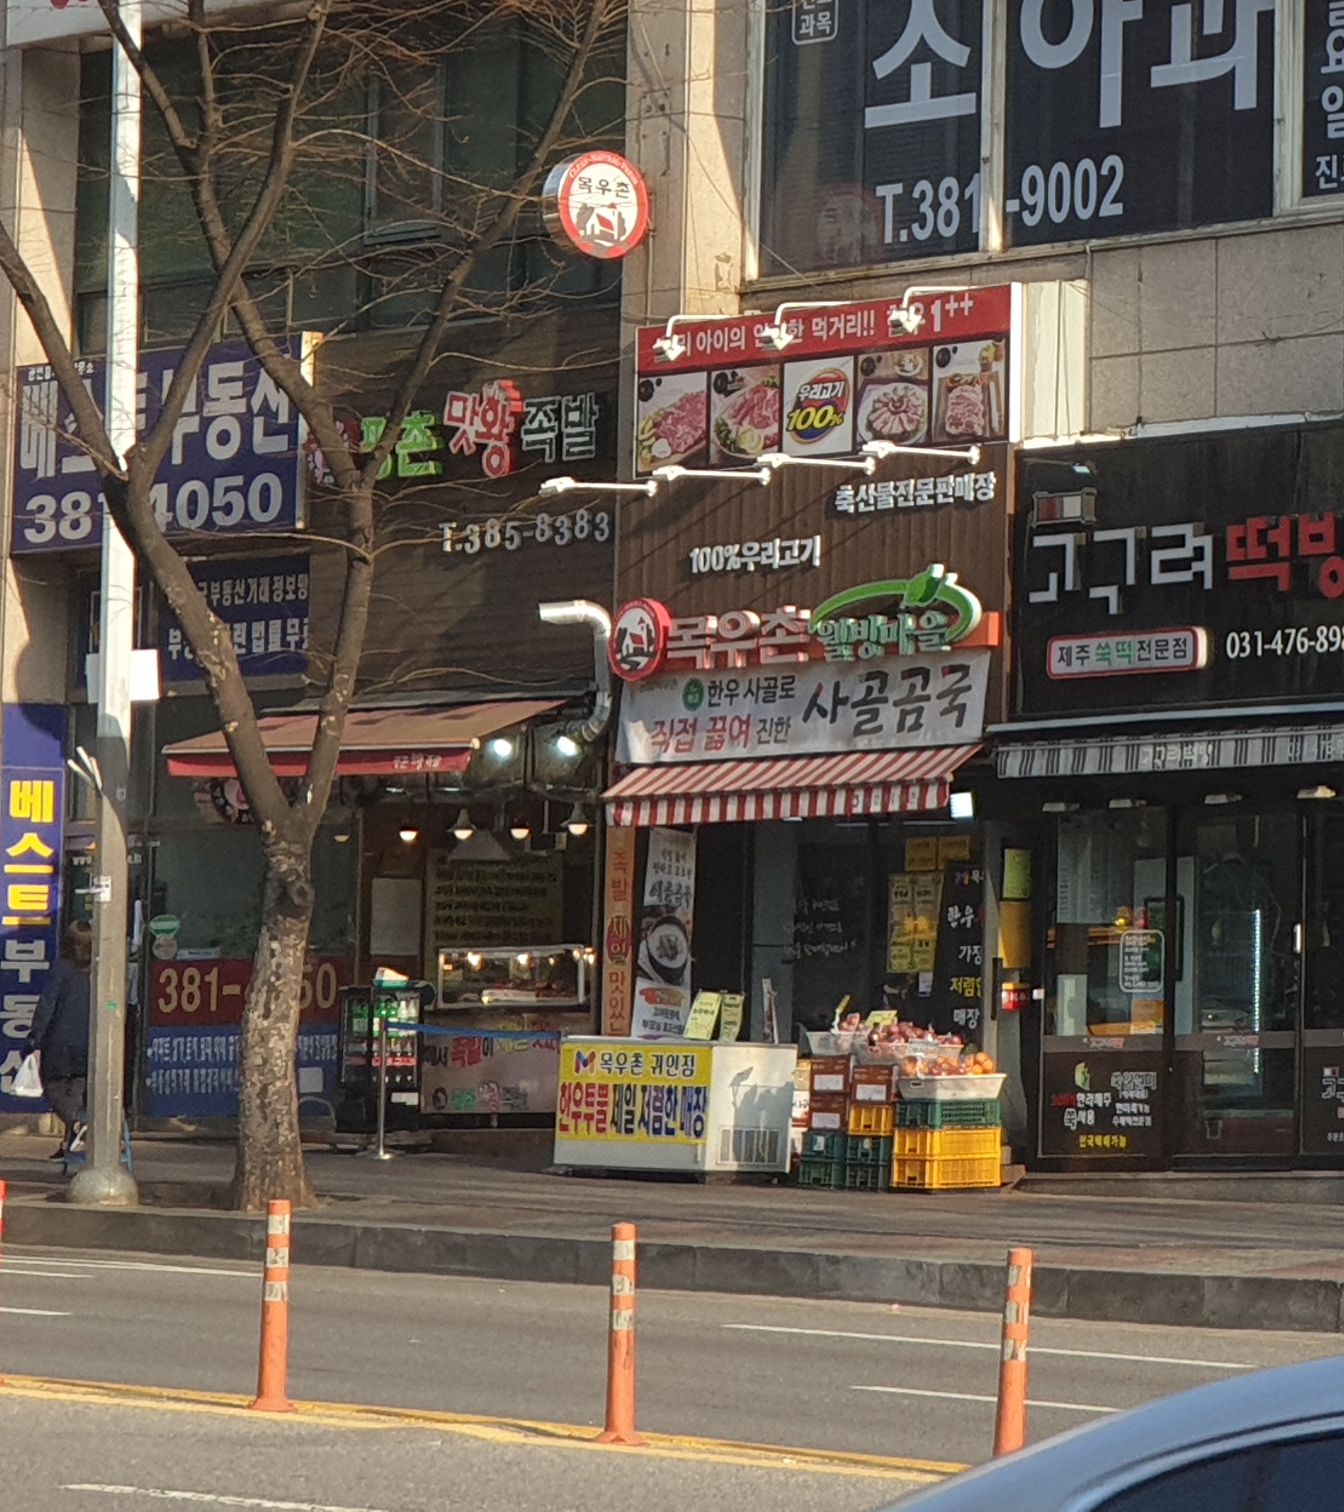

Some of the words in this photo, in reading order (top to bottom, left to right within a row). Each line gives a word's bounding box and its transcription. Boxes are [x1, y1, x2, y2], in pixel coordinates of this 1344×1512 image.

[799, 11, 834, 38] 과목
[696, 326, 746, 352] 아이의
[811, 310, 876, 339] 먹거리!!
[798, 381, 846, 402] 우리고기
[521, 392, 599, 464] 족발
[786, 403, 845, 432] 100%
[834, 471, 996, 514] 축산물전문판매장
[438, 508, 611, 554] T.385-8383
[689, 534, 822, 574] 100%우리고기
[665, 605, 812, 668] 목우촌
[816, 610, 952, 662] 웰빙마을
[707, 678, 740, 708] 한우
[743, 674, 797, 703] 사골로
[801, 663, 973, 738] 사골곰국
[650, 716, 699, 755] 직접
[704, 713, 752, 752] 끓여
[755, 716, 792, 745] 진한
[600, 1052, 644, 1076] 목우촌
